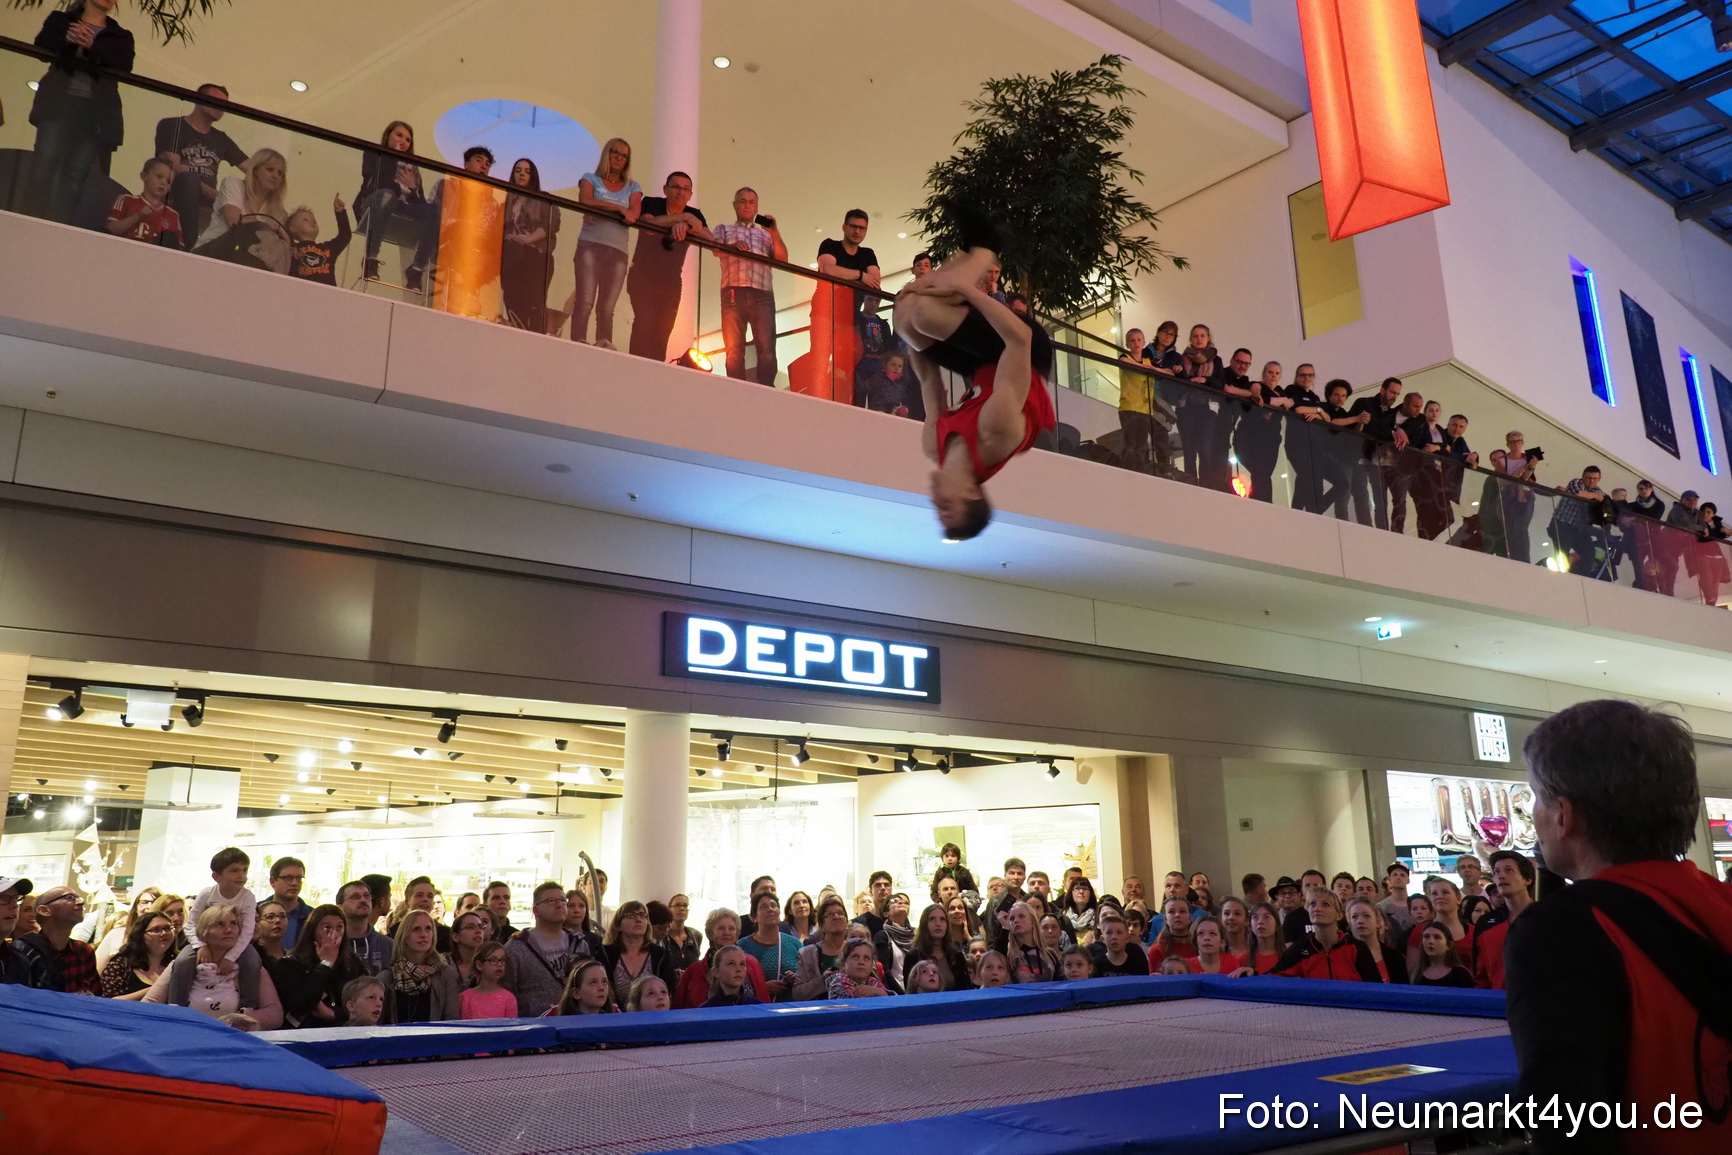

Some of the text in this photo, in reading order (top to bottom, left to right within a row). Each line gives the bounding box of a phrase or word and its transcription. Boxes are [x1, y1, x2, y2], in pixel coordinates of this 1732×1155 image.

[687, 617, 928, 689] DEPOT
[1478, 716, 1505, 735] LUISA
[1481, 738, 1508, 758] LUISA
